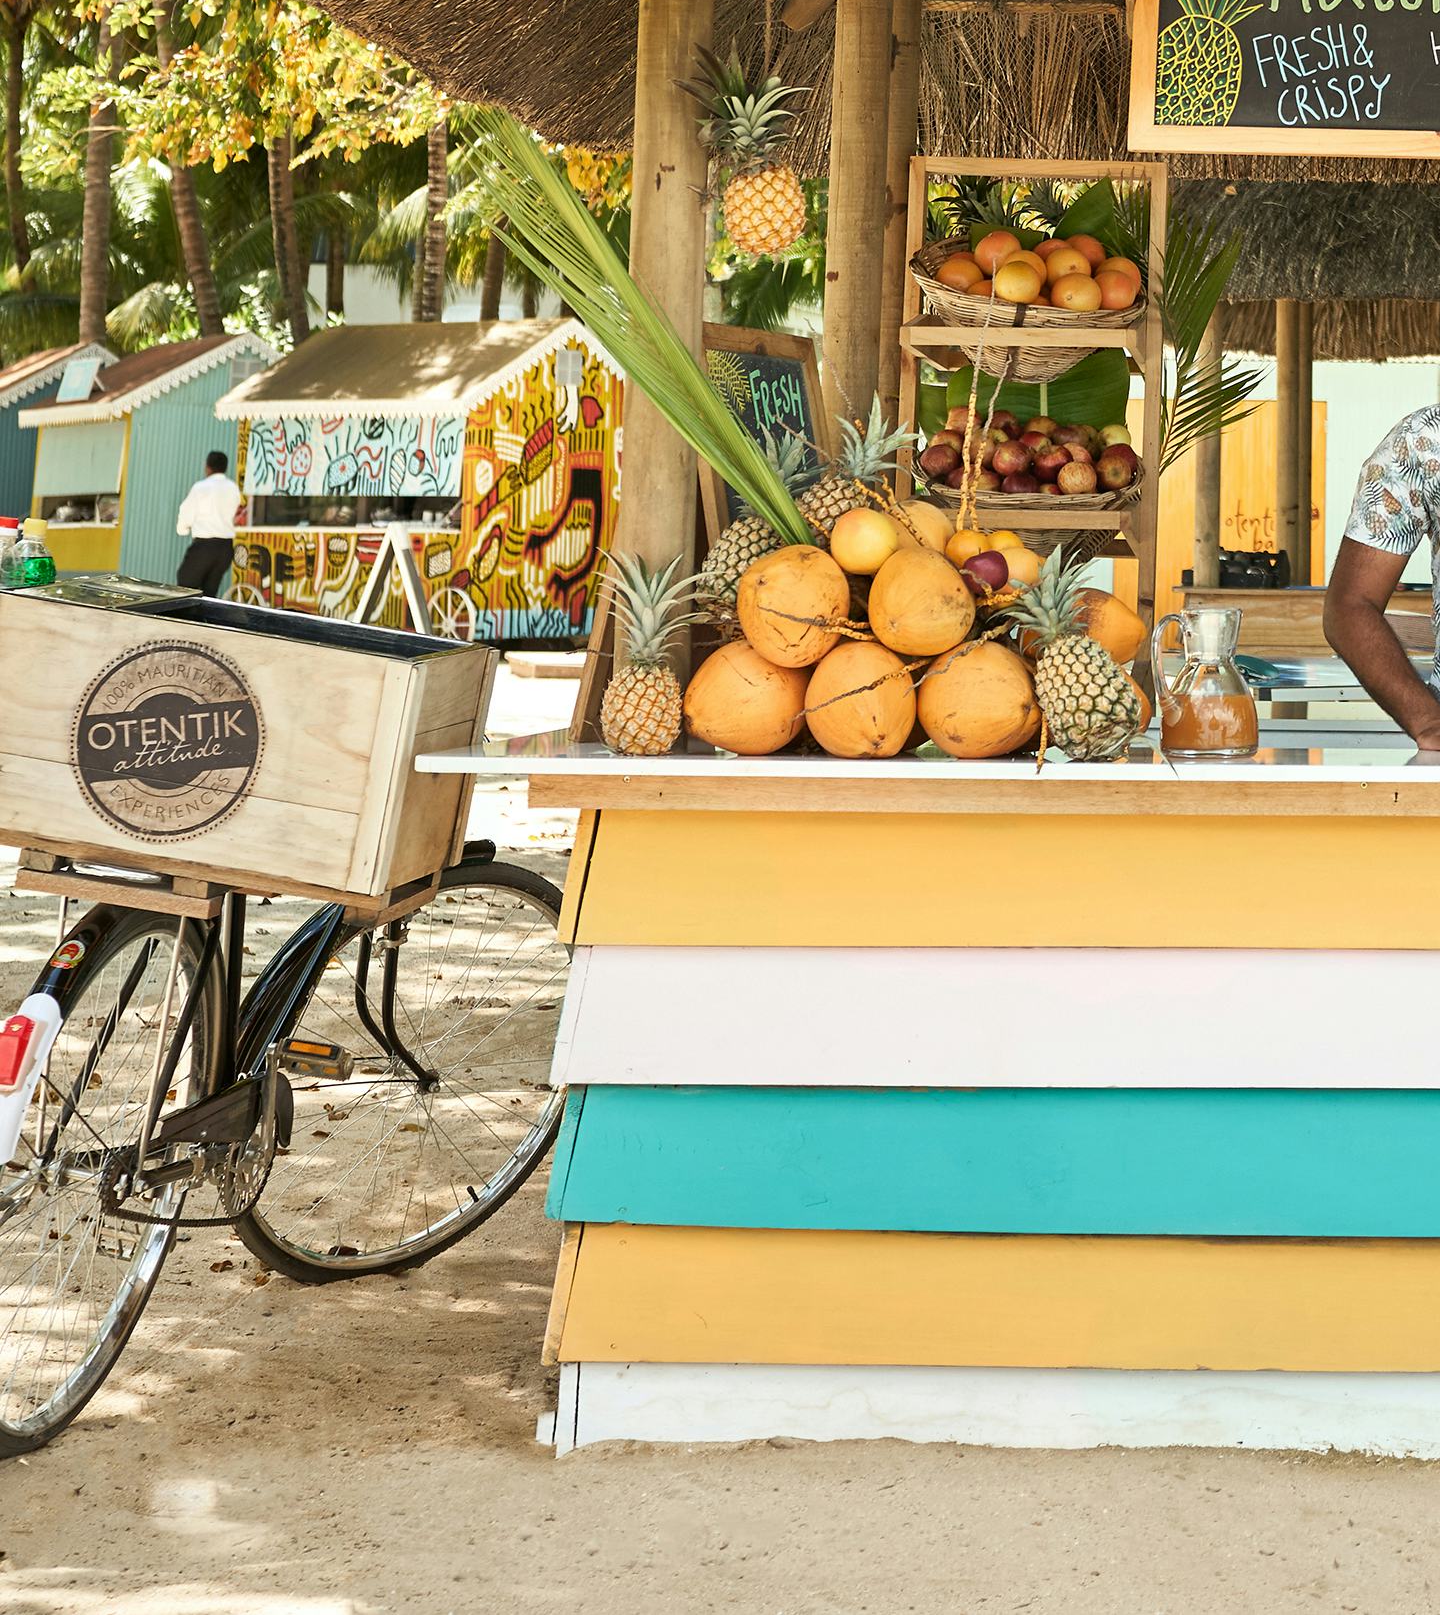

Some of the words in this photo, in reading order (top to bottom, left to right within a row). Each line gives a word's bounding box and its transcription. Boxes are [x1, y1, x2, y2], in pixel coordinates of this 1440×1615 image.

[749, 368, 805, 431] FRESH
[102, 679, 135, 710] 100%
[137, 664, 229, 698] MAURITIAN
[87, 709, 247, 751] OTENTIK
[113, 735, 226, 773] attitude
[110, 773, 231, 819] EXPERIENCES
